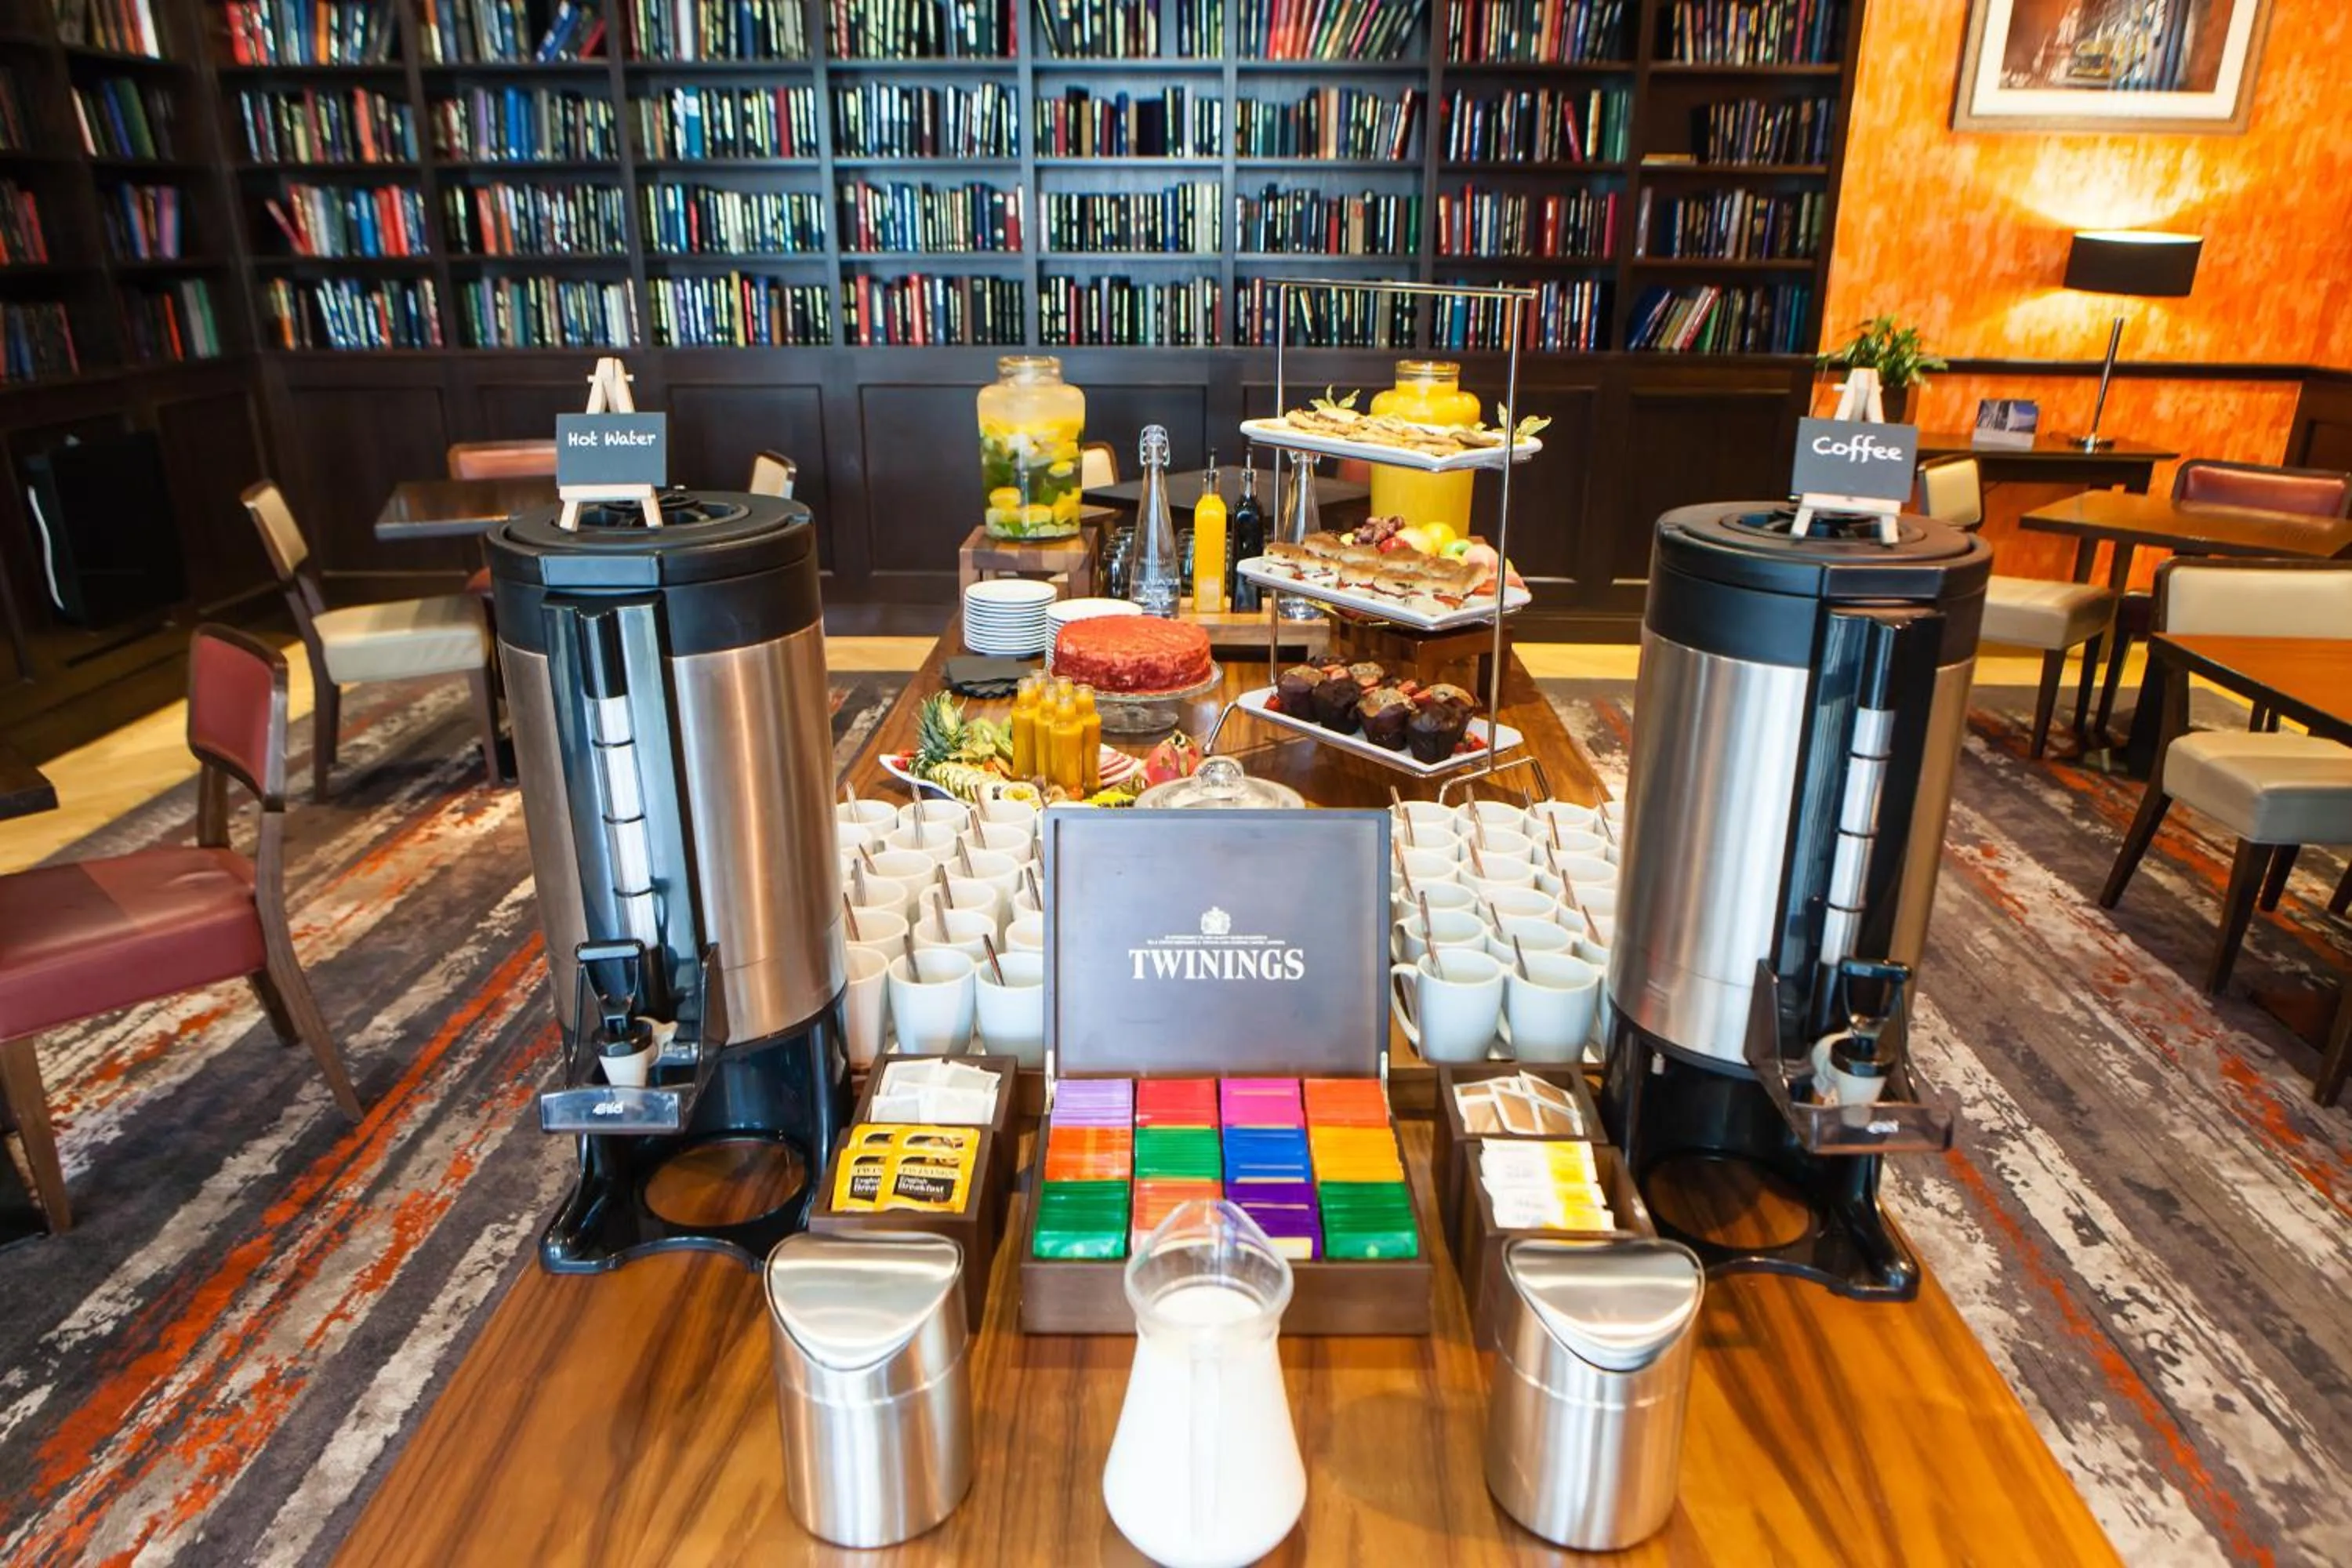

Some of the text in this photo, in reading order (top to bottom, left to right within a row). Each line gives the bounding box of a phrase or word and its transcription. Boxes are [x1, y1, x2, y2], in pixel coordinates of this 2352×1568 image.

[568, 430, 656, 447] Hot Water
[1812, 434, 1903, 463] Coffee
[1128, 949, 1305, 980] TWININGS
